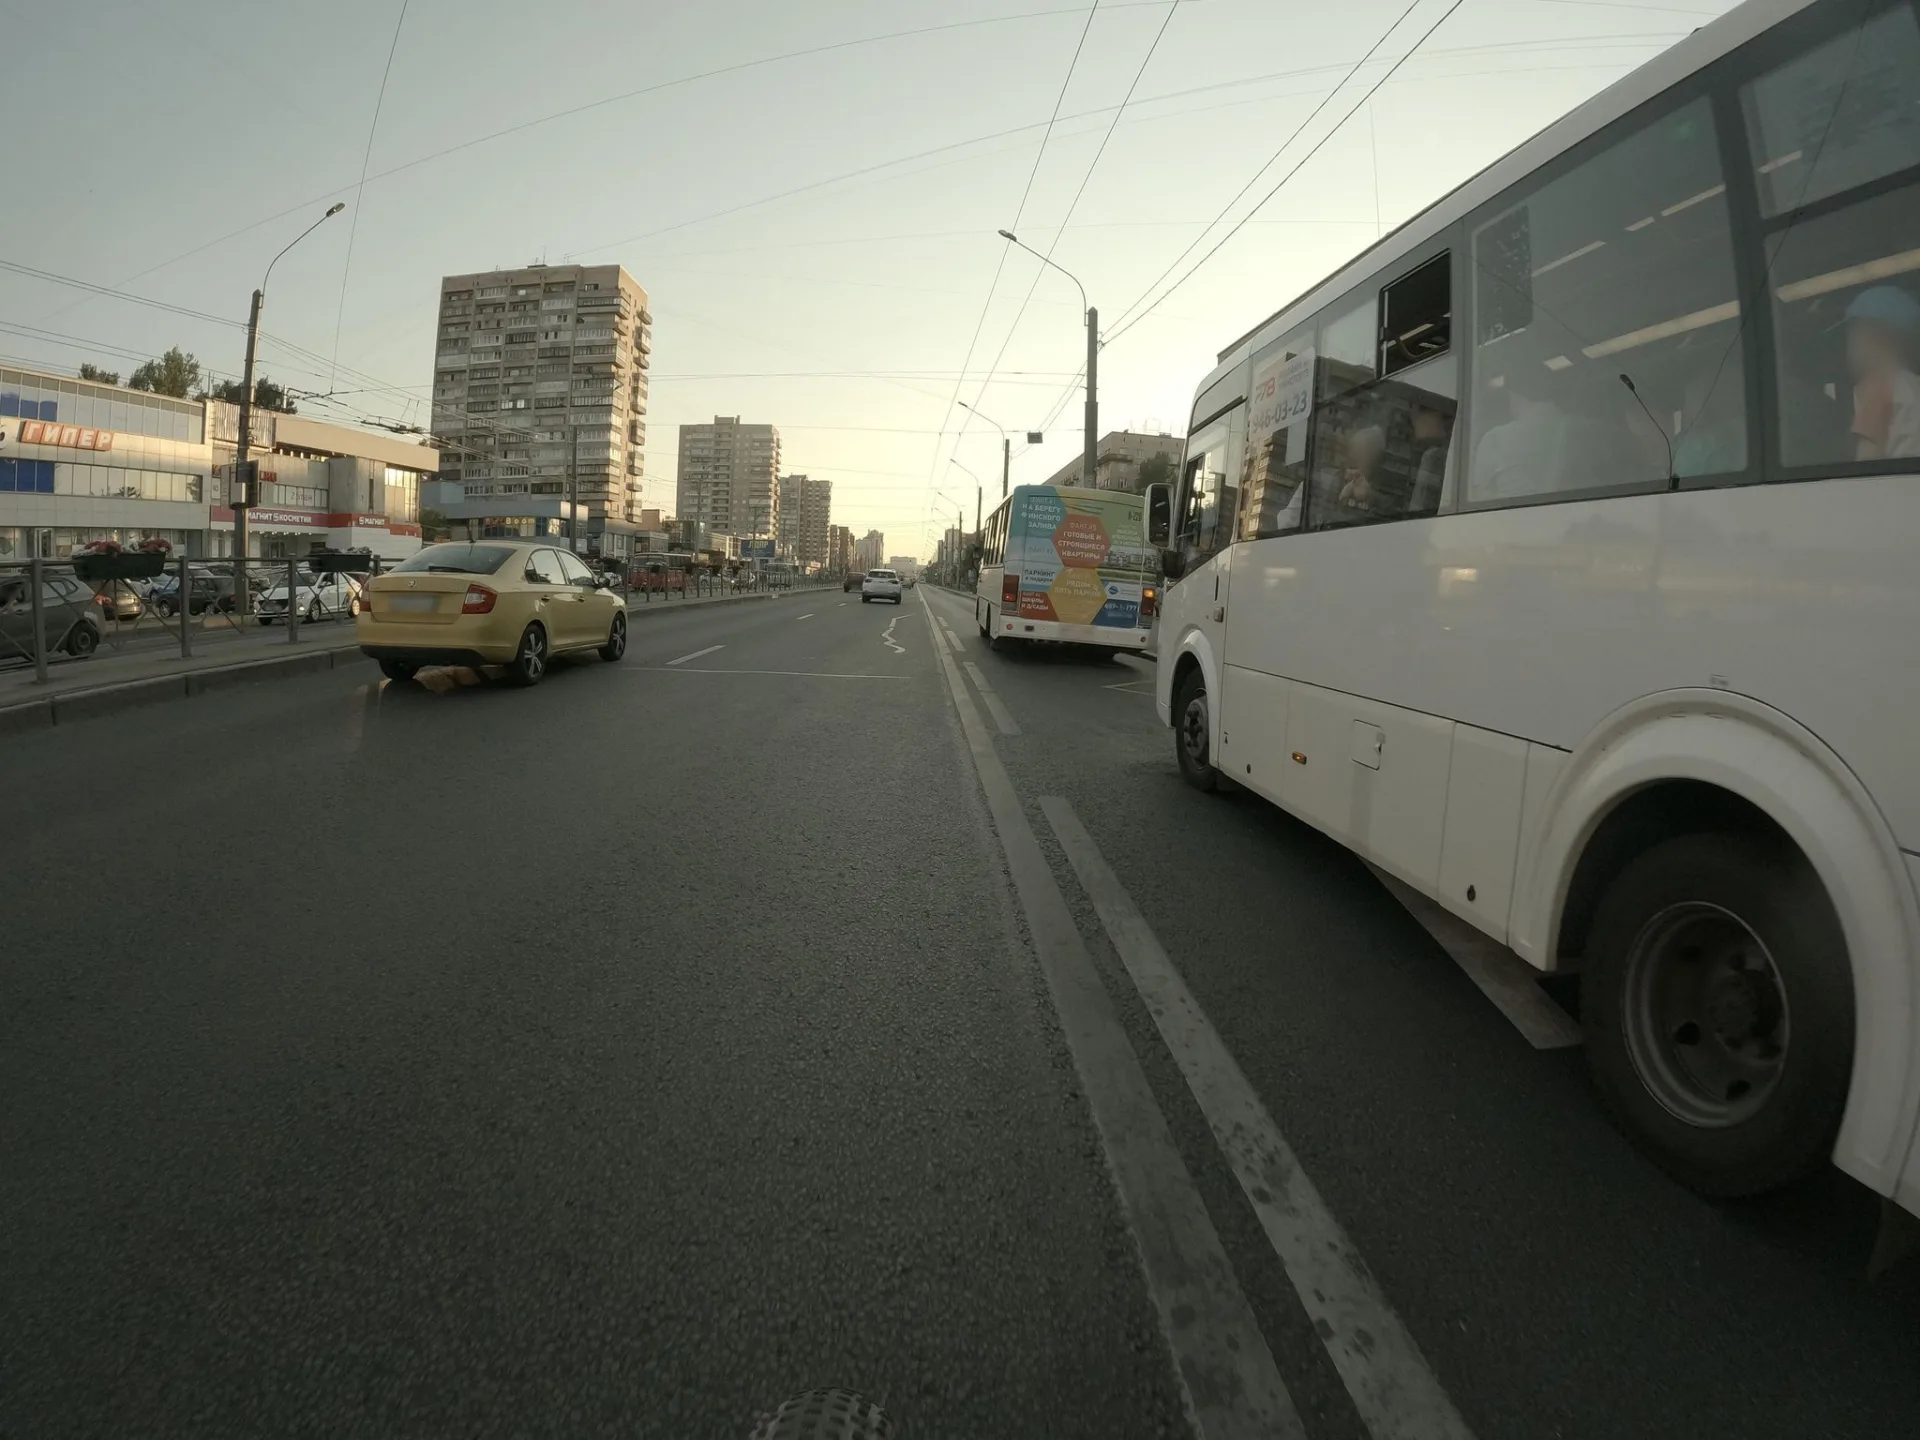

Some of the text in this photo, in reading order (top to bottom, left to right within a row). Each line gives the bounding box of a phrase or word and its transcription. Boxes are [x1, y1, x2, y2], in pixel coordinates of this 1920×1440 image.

[1252, 390, 1308, 434] 946-03-23
[26, 422, 111, 448] ГИПЕР
[1035, 505, 1061, 513] БЕРЕГУ
[280, 514, 312, 523] КОСМЕТИК
[1021, 511, 1061, 521] ФИНСКОГО
[364, 518, 385, 526] МАГНИТ
[1028, 521, 1057, 530] ЗАЛИВА
[1063, 531, 1095, 540] ГОТОВЫЕ
[1058, 540, 1105, 551] СТРОЯЩИЕСЯ
[1062, 551, 1101, 560] КВАРТИРЫ
[1024, 569, 1056, 577] ПАРКИНГ
